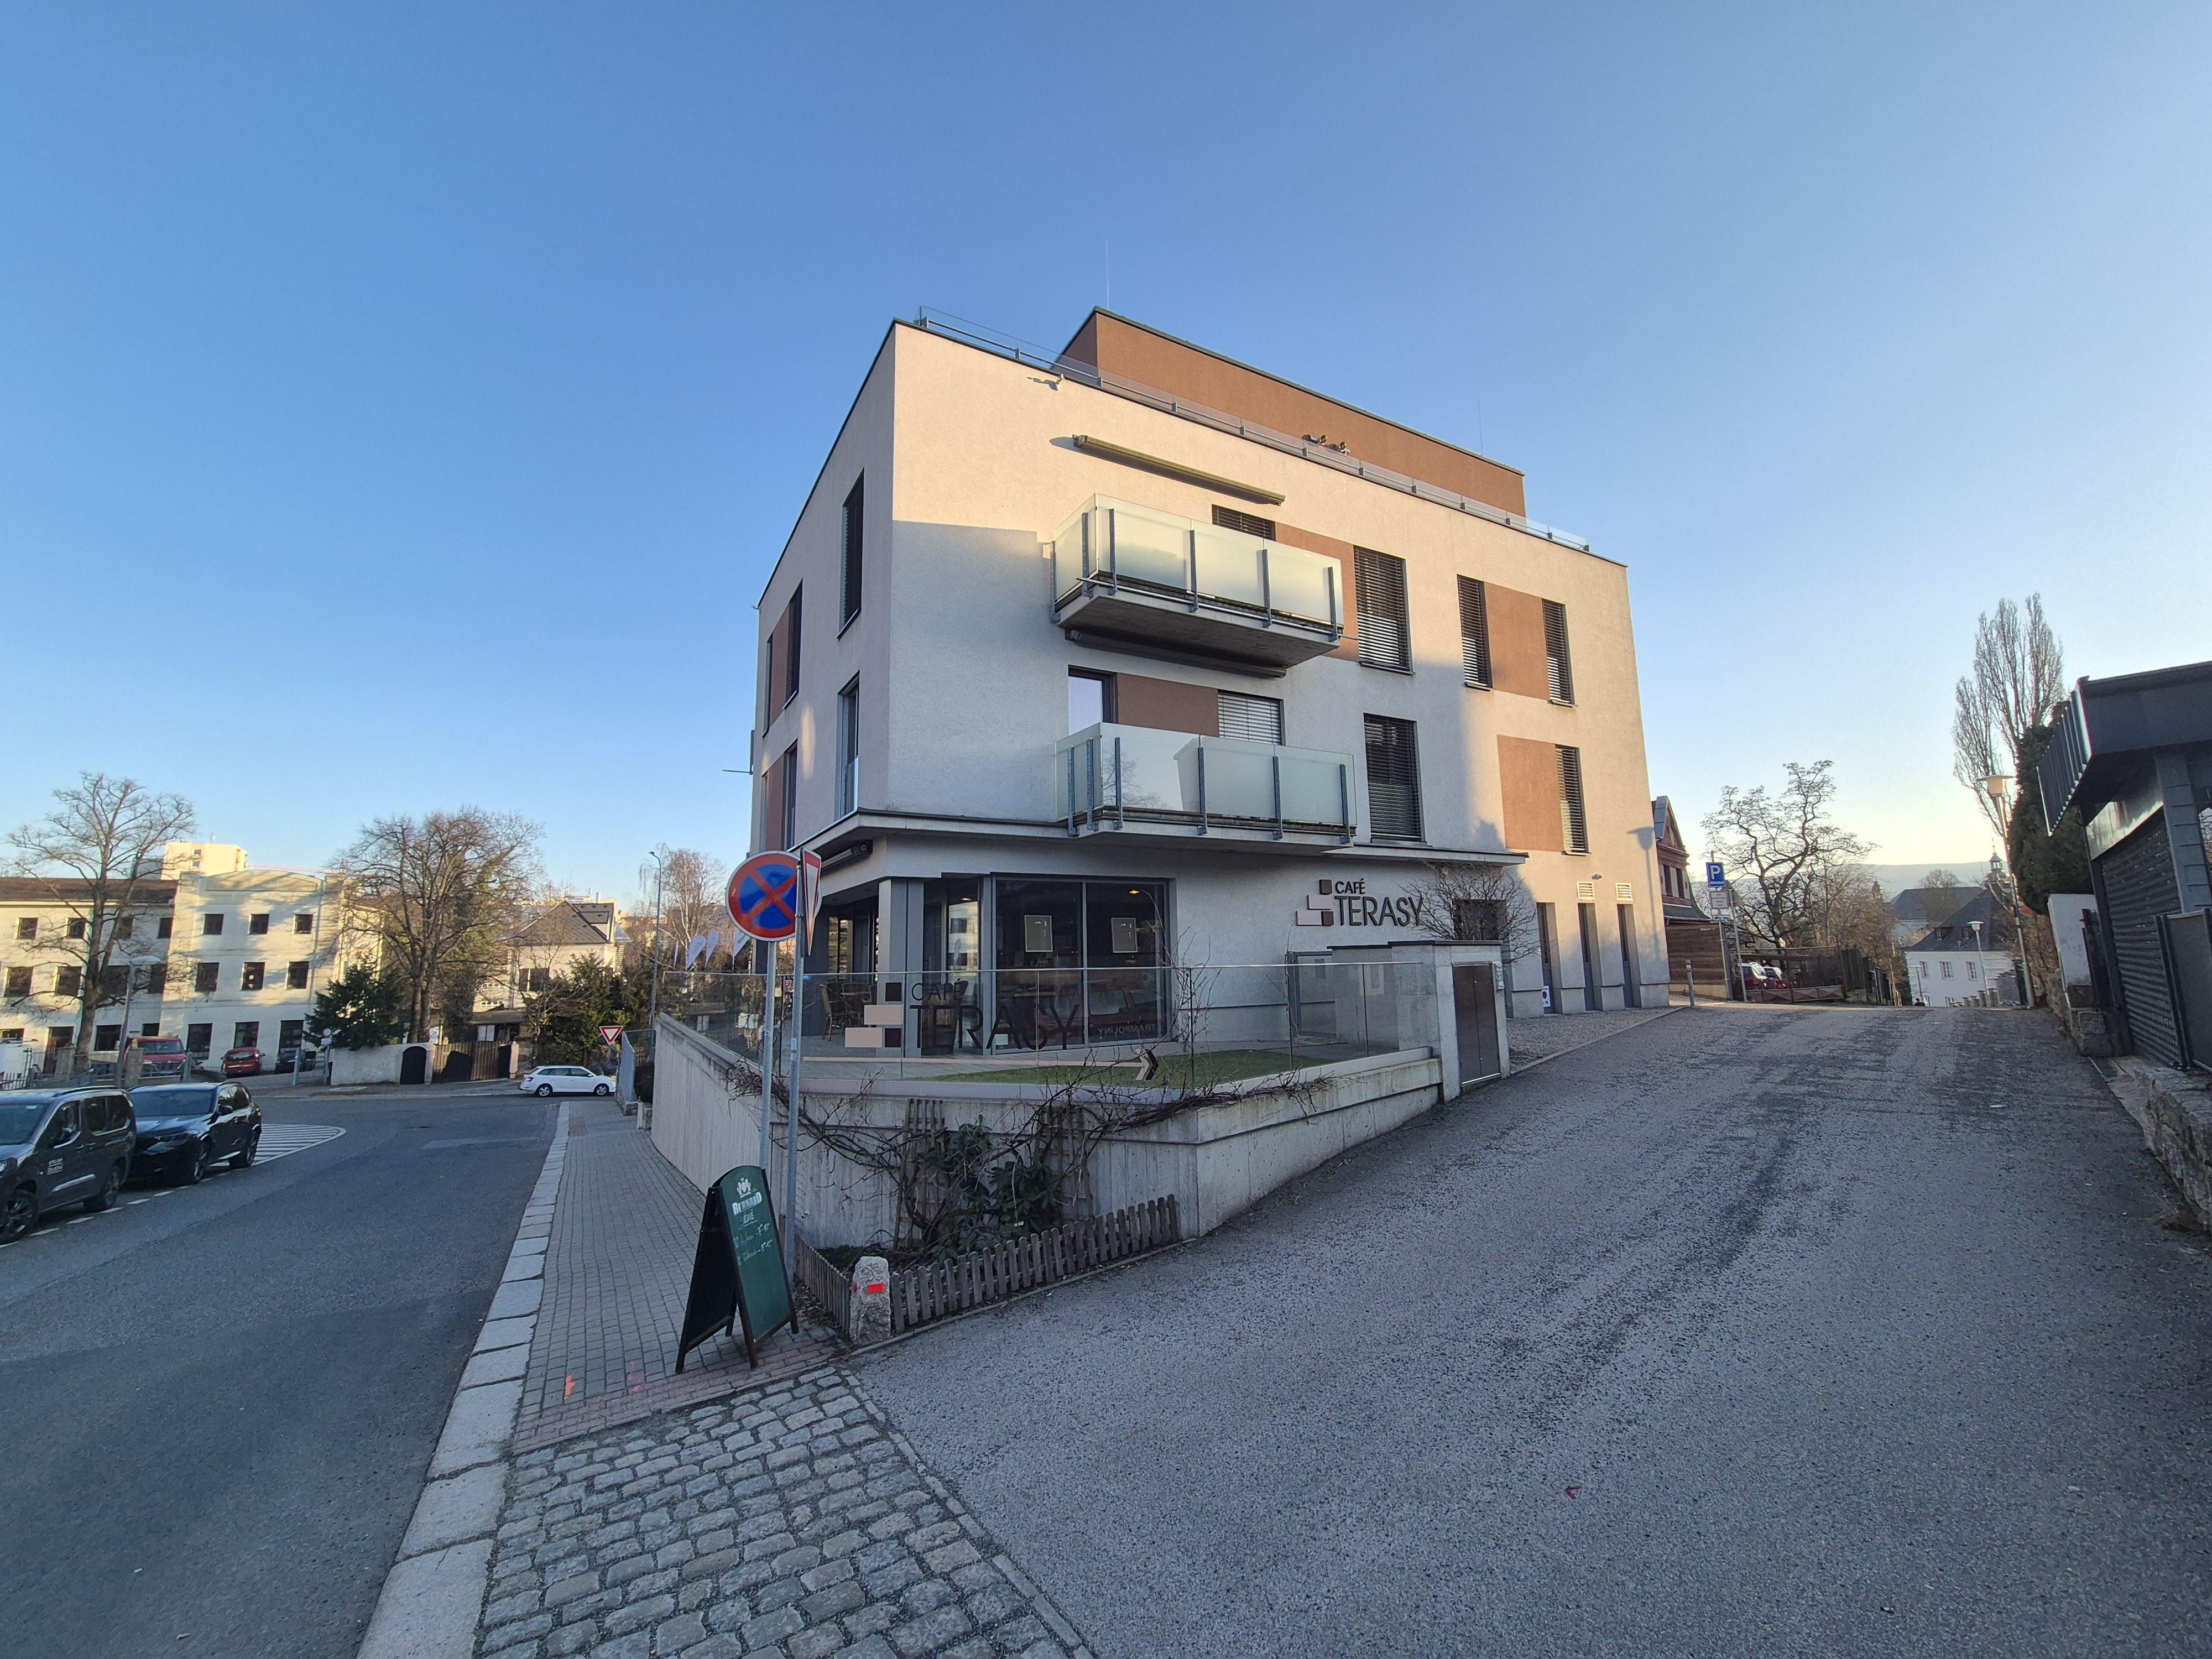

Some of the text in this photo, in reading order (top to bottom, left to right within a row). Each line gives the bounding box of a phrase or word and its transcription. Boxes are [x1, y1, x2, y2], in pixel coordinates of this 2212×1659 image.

[1710, 865, 1720, 879] P
[1335, 878, 1365, 894] CAFÉ
[1334, 895, 1423, 927] TERASY
[911, 978, 963, 1001] CAFÉ
[909, 1004, 1079, 1050] TERASY
